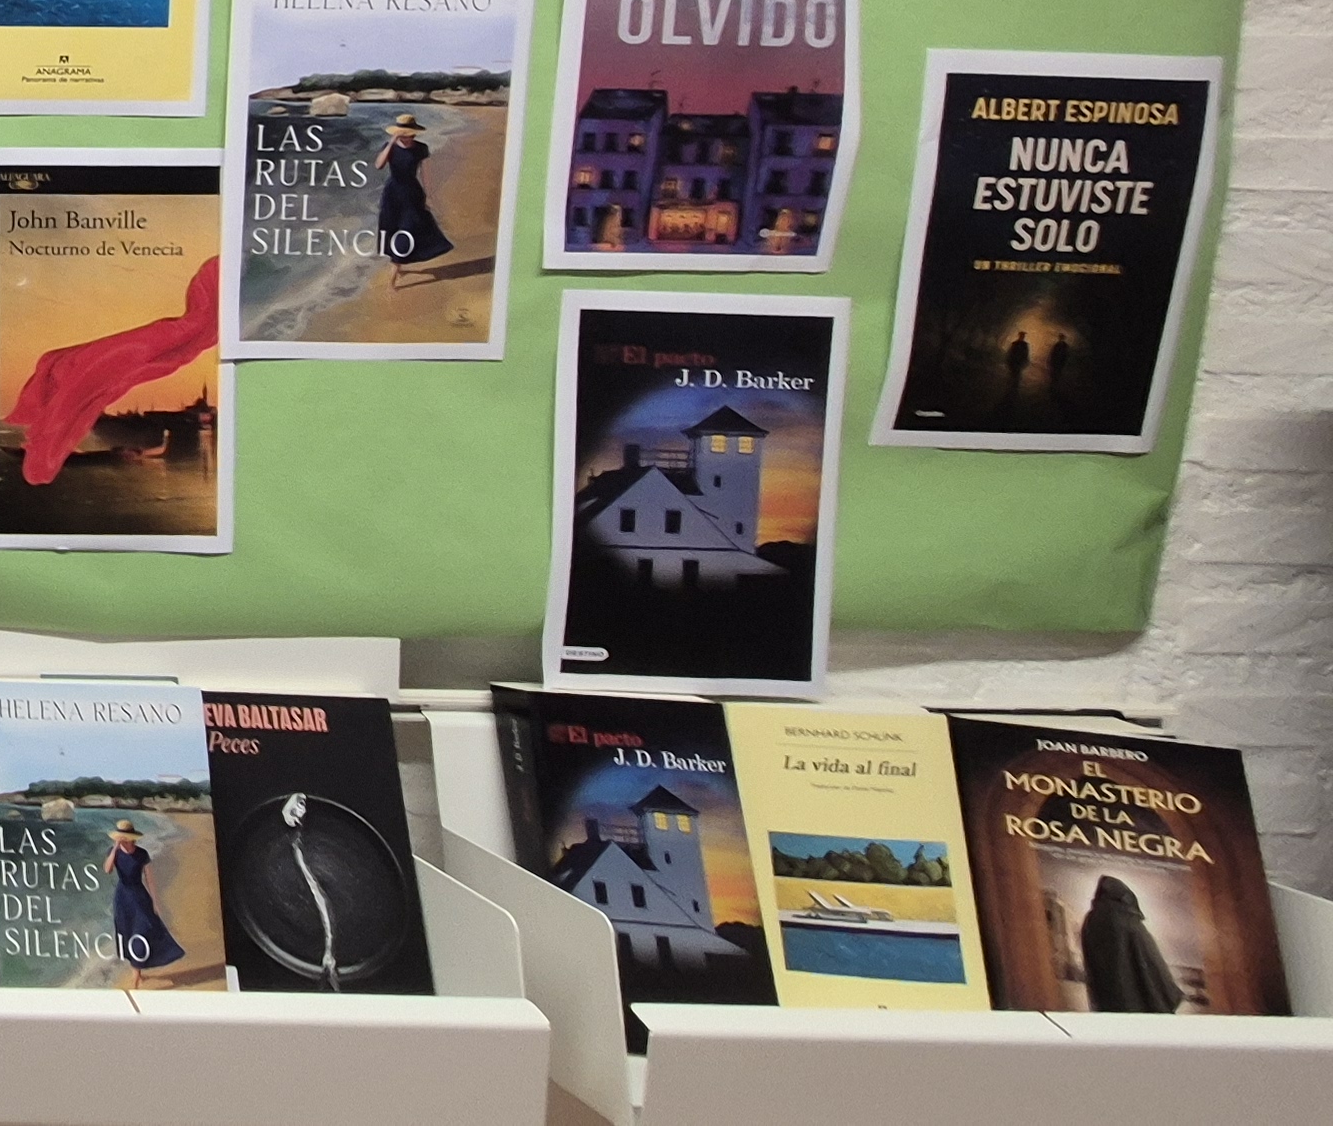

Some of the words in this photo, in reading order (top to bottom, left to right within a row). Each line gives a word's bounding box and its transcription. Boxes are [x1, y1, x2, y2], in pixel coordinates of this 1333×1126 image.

[971, 97, 1060, 121] ALBERT
[1065, 100, 1179, 125] ESPINOSA
[1009, 137, 1129, 174] NUNCA
[255, 159, 368, 188] RUTAS
[973, 176, 1154, 215] ESTUVISTE
[7, 210, 57, 233] John
[66, 210, 147, 229] Banville
[1010, 218, 1100, 253] SOLO
[9, 241, 90, 256] Nocturno
[96, 241, 115, 256] de
[121, 241, 183, 256] Venecia
[252, 228, 414, 257] SILENCIO
[675, 368, 695, 388] J.
[704, 370, 727, 388] D.
[737, 370, 814, 390] Barker
[93, 702, 182, 723] RESANO
[1037, 739, 1077, 753] JOAN
[1080, 744, 1148, 762] BARBERO
[1003, 770, 1203, 814] MONASTERIO
[1004, 813, 1091, 845] ROSA
[1095, 826, 1215, 864] NEGRA
